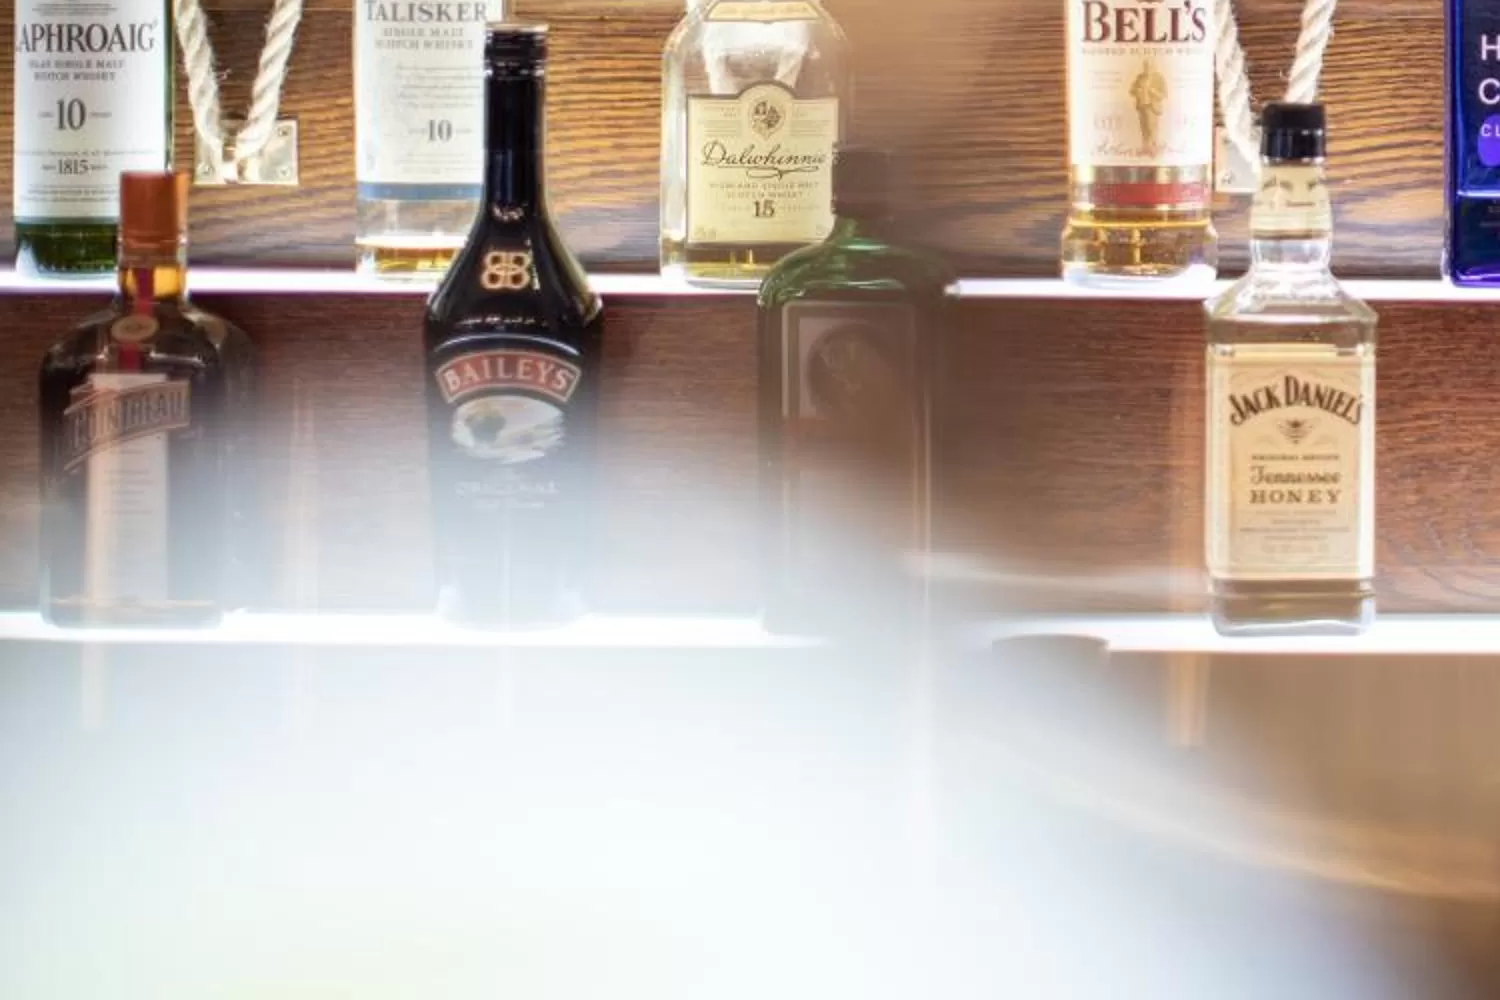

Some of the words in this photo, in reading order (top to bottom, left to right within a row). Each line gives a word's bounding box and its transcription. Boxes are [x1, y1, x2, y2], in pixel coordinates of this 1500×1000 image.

[364, 0, 488, 22] TALISKER
[1081, 0, 1207, 43] BELL'S
[15, 21, 156, 53] APHROAIG
[56, 98, 87, 132] 10
[427, 119, 453, 142] 10
[57, 159, 89, 176] 1815
[754, 200, 776, 218] 15
[443, 357, 570, 392] BAILEYS
[1229, 384, 1282, 426] JACK
[1248, 464, 1343, 485] Tennessee
[1248, 488, 1342, 504] HONEY
